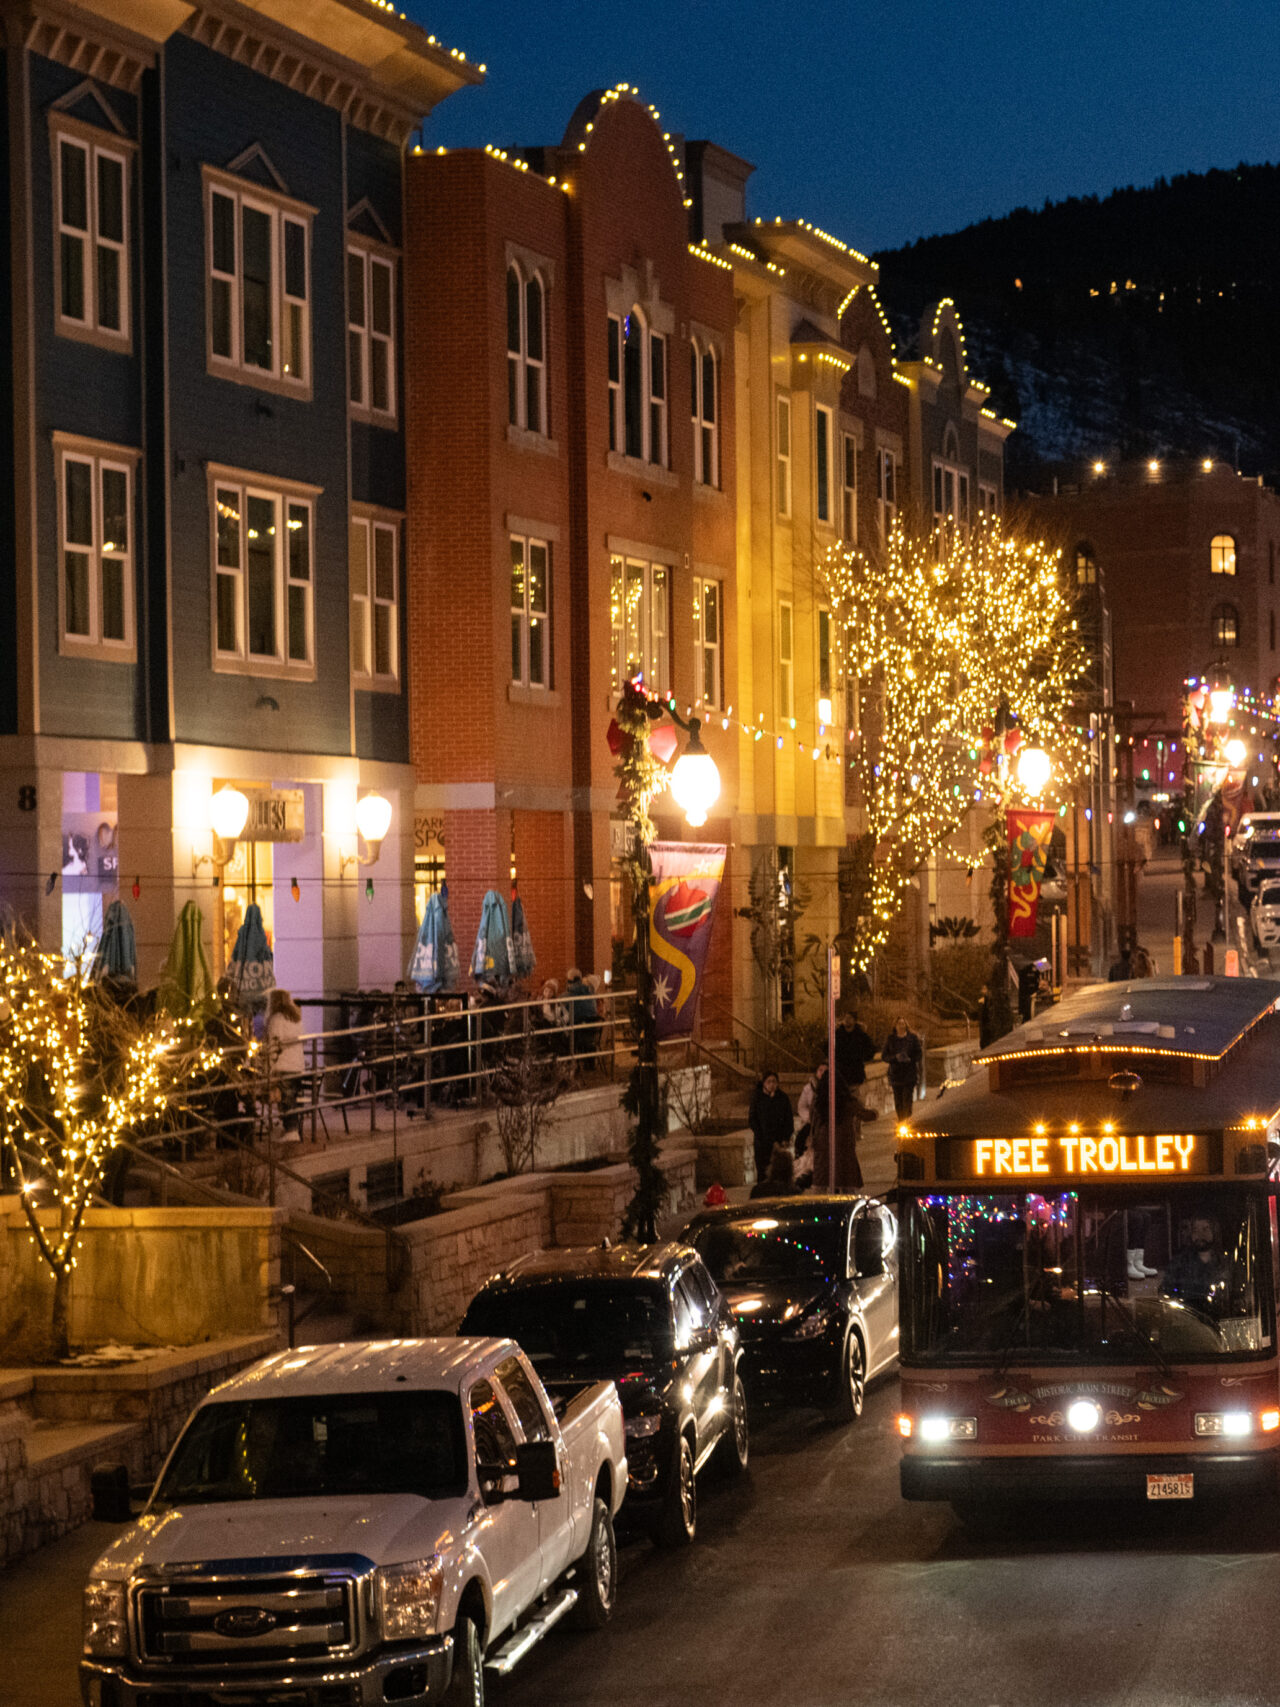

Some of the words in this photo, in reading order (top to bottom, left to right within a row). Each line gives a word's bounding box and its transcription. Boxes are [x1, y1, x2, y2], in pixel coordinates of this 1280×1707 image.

[17, 785, 37, 811] 8
[975, 1138, 1049, 1174] FREE
[1059, 1134, 1194, 1172] TROLLEY
[1077, 1383, 1099, 1394] MAIN
[1102, 1384, 1131, 1398] STREET
[1032, 1434, 1061, 1442] PARK
[1095, 1433, 1138, 1442] TRANSIT
